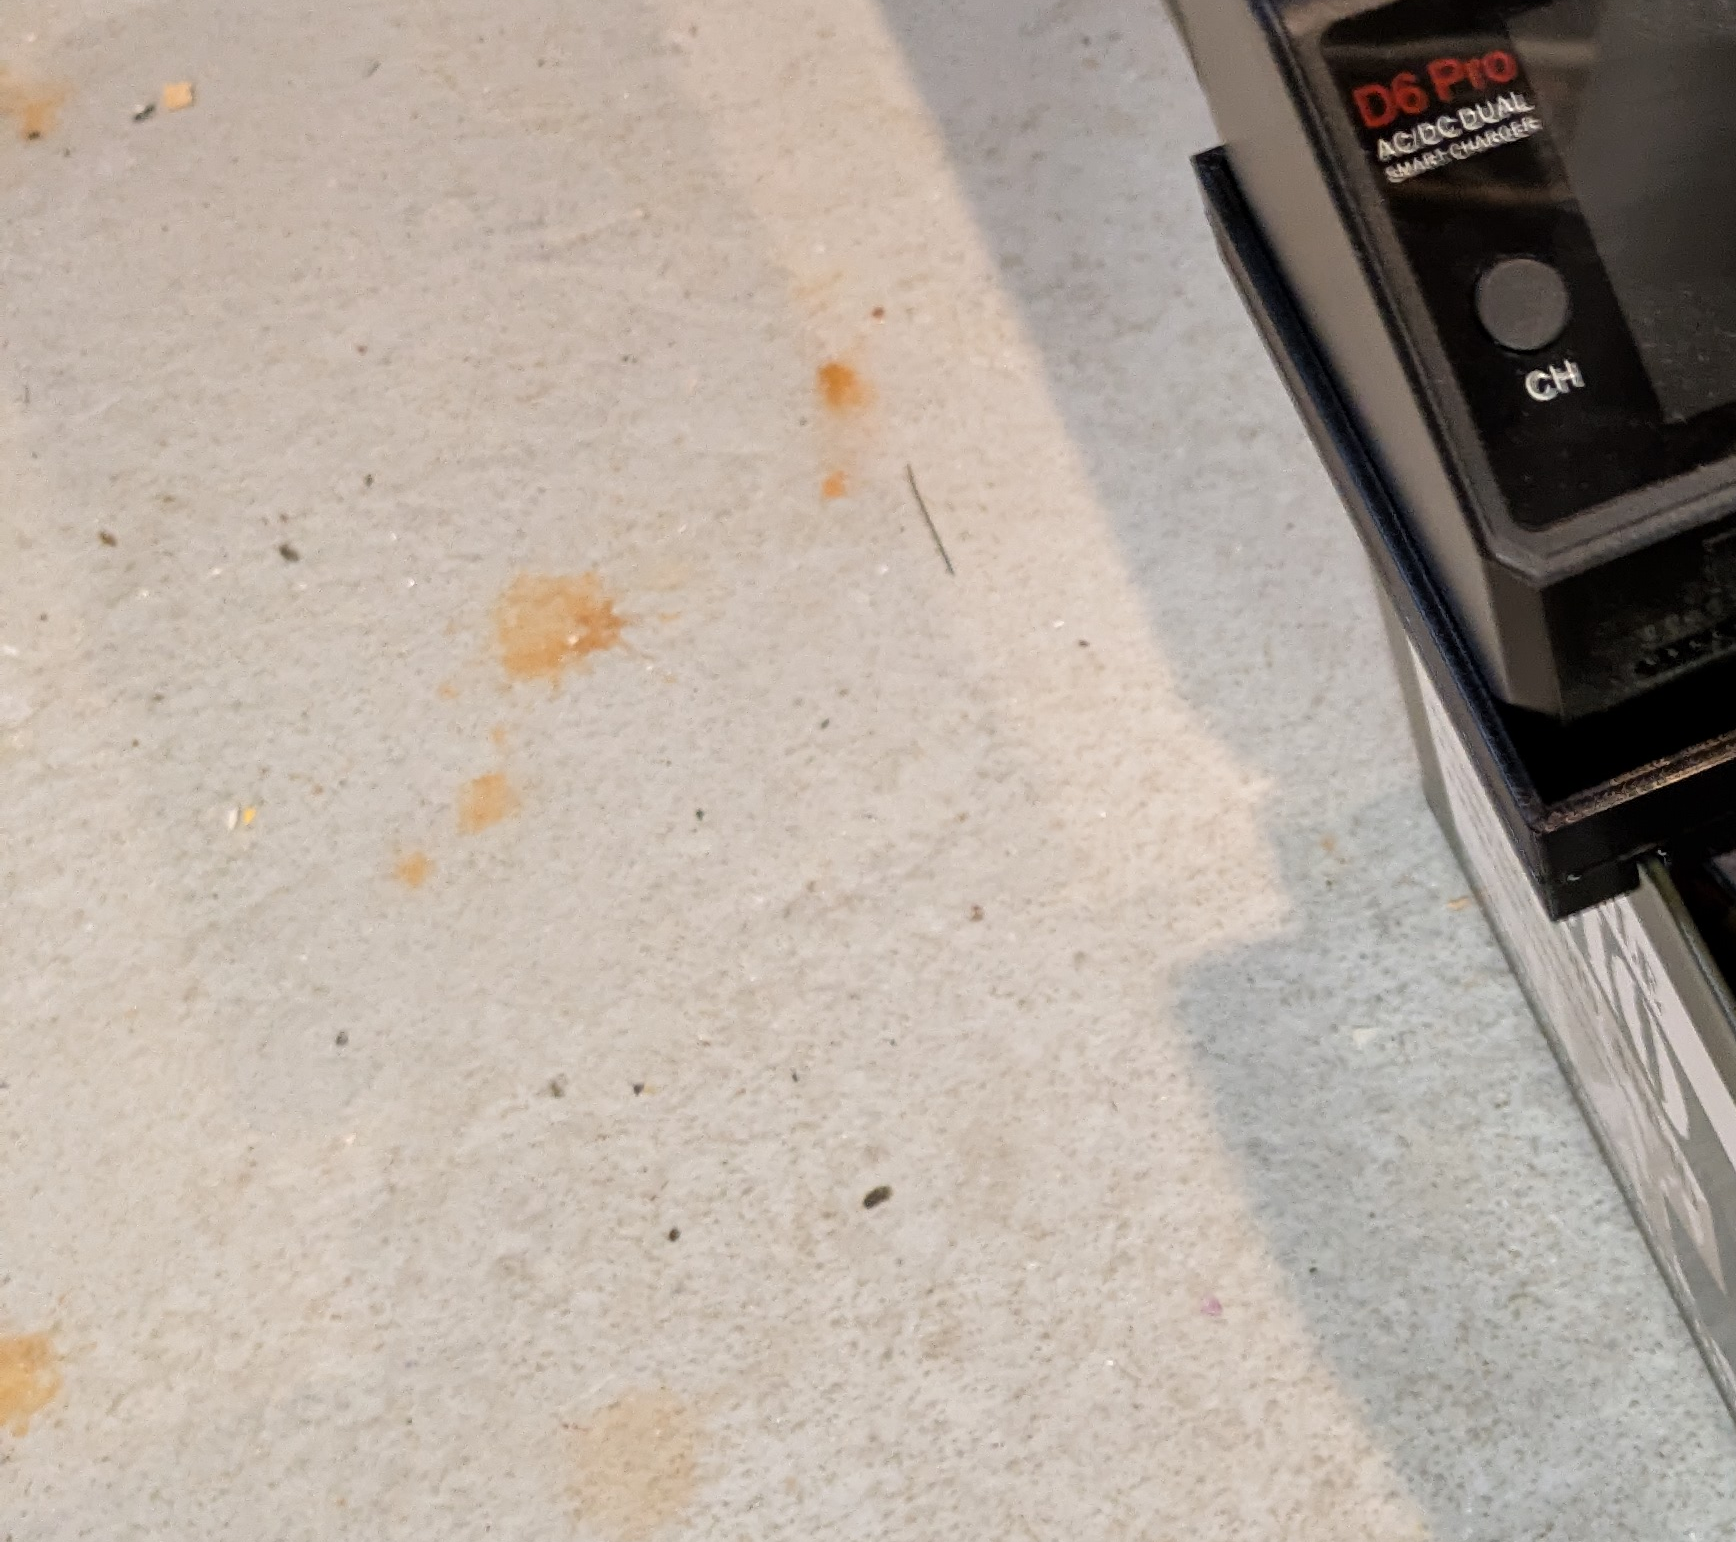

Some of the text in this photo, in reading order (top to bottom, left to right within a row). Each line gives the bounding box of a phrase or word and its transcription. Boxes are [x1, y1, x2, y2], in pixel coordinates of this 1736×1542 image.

[1352, 50, 1518, 129] D6 Pro
[1377, 92, 1536, 163] AC/DC DUAL
[1384, 117, 1543, 183] SMART CHARGER
[1525, 359, 1586, 402] CH
